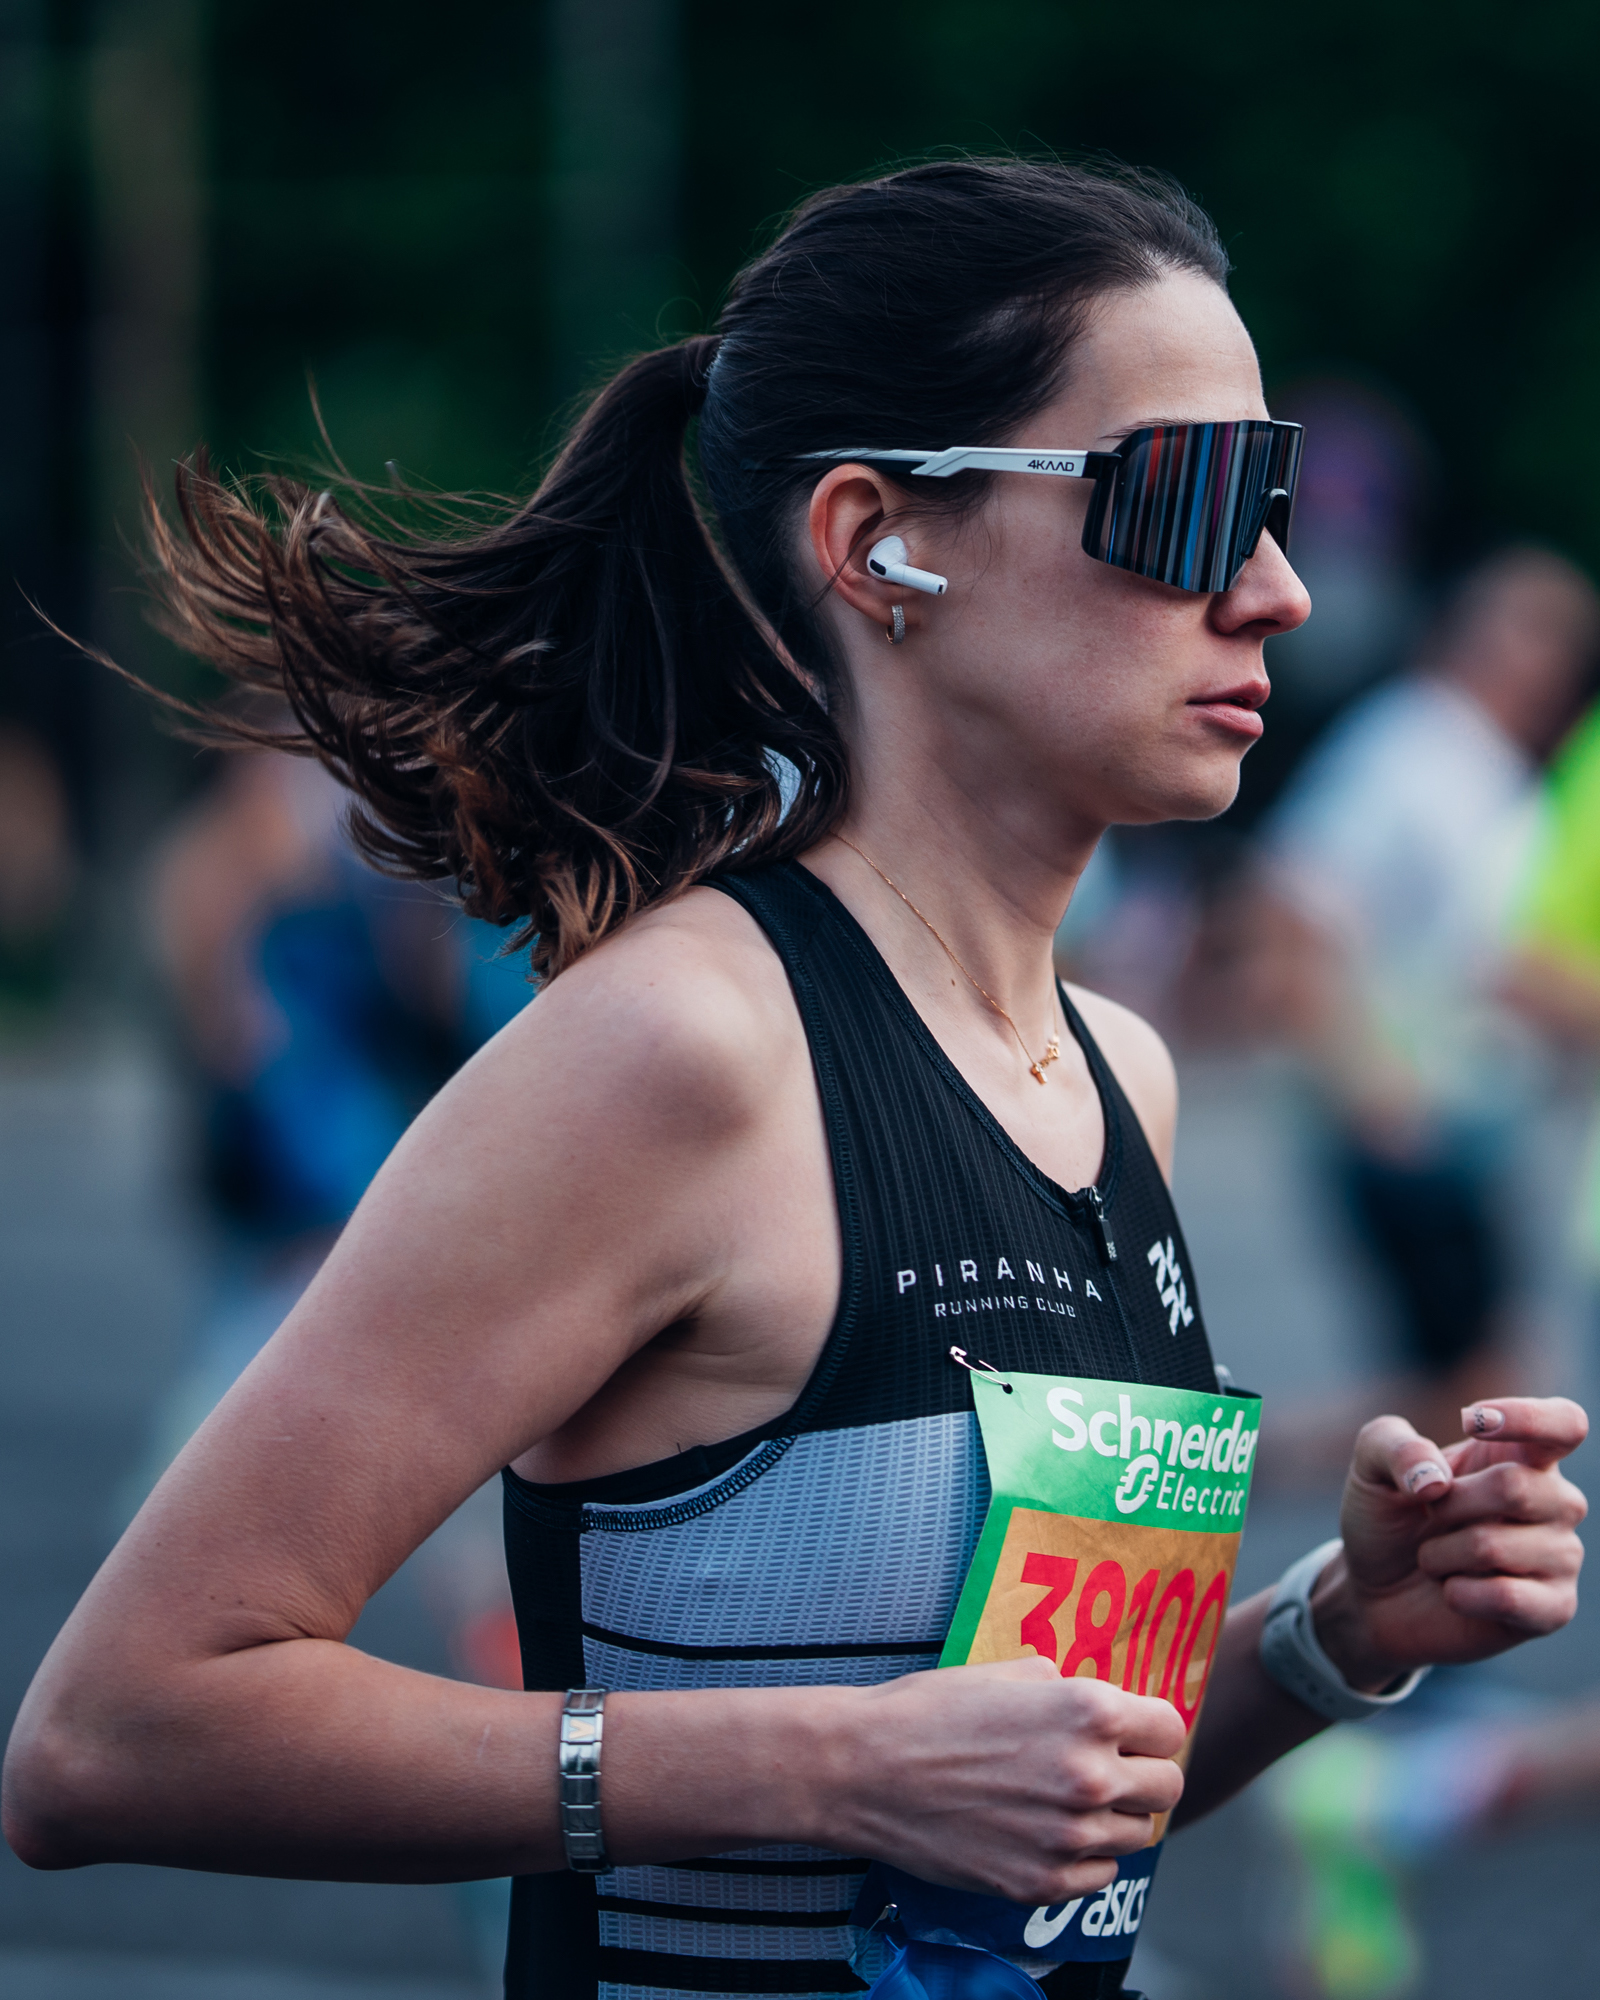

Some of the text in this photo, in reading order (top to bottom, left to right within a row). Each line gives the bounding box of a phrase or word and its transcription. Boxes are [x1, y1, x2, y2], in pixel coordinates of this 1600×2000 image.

[896, 1257, 1102, 1302] PIRANHA
[934, 1295, 1077, 1318] RUNNING CLUB
[1045, 1386, 1259, 1474] Schneider
[1156, 1470, 1245, 1516] Electric
[1020, 1551, 1227, 1736] 38100
